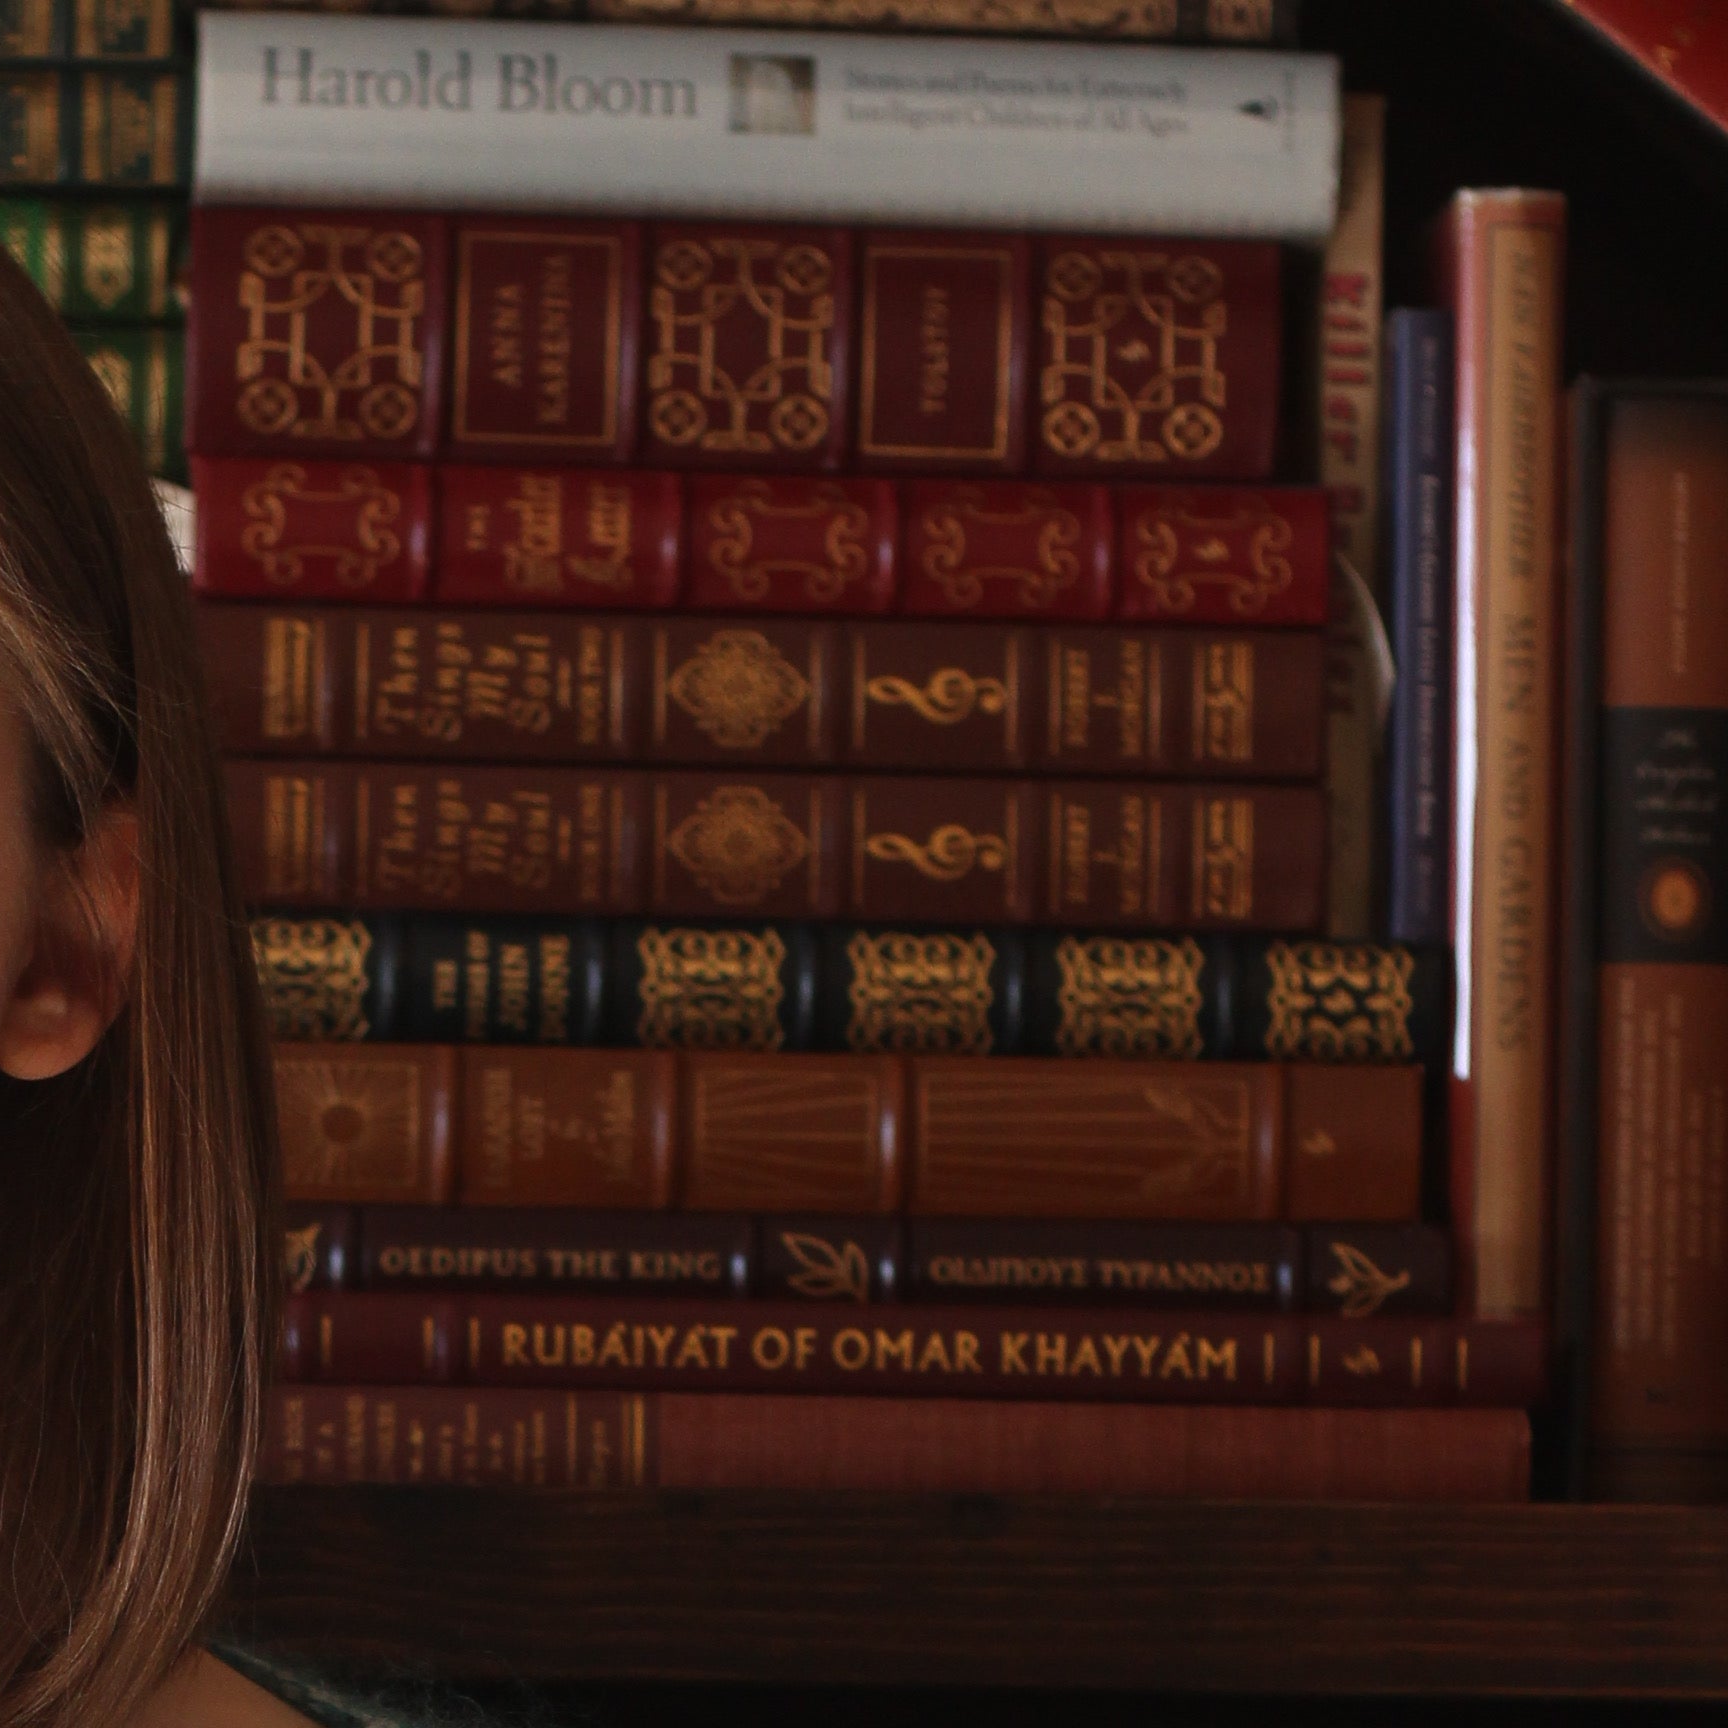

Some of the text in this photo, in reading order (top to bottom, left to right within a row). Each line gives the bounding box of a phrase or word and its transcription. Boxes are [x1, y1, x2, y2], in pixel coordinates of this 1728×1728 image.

[259, 44, 700, 118] Harold Bloom
[491, 281, 523, 388] ANNA
[536, 253, 572, 425] KARENINA
[1501, 612, 1537, 714] MEN
[1500, 737, 1535, 820] AND
[1495, 836, 1539, 1053] GARDENS
[378, 1246, 720, 1282] OEDIPUS THE KING
[751, 1326, 818, 1371] OF
[830, 1325, 984, 1374] OMAR
